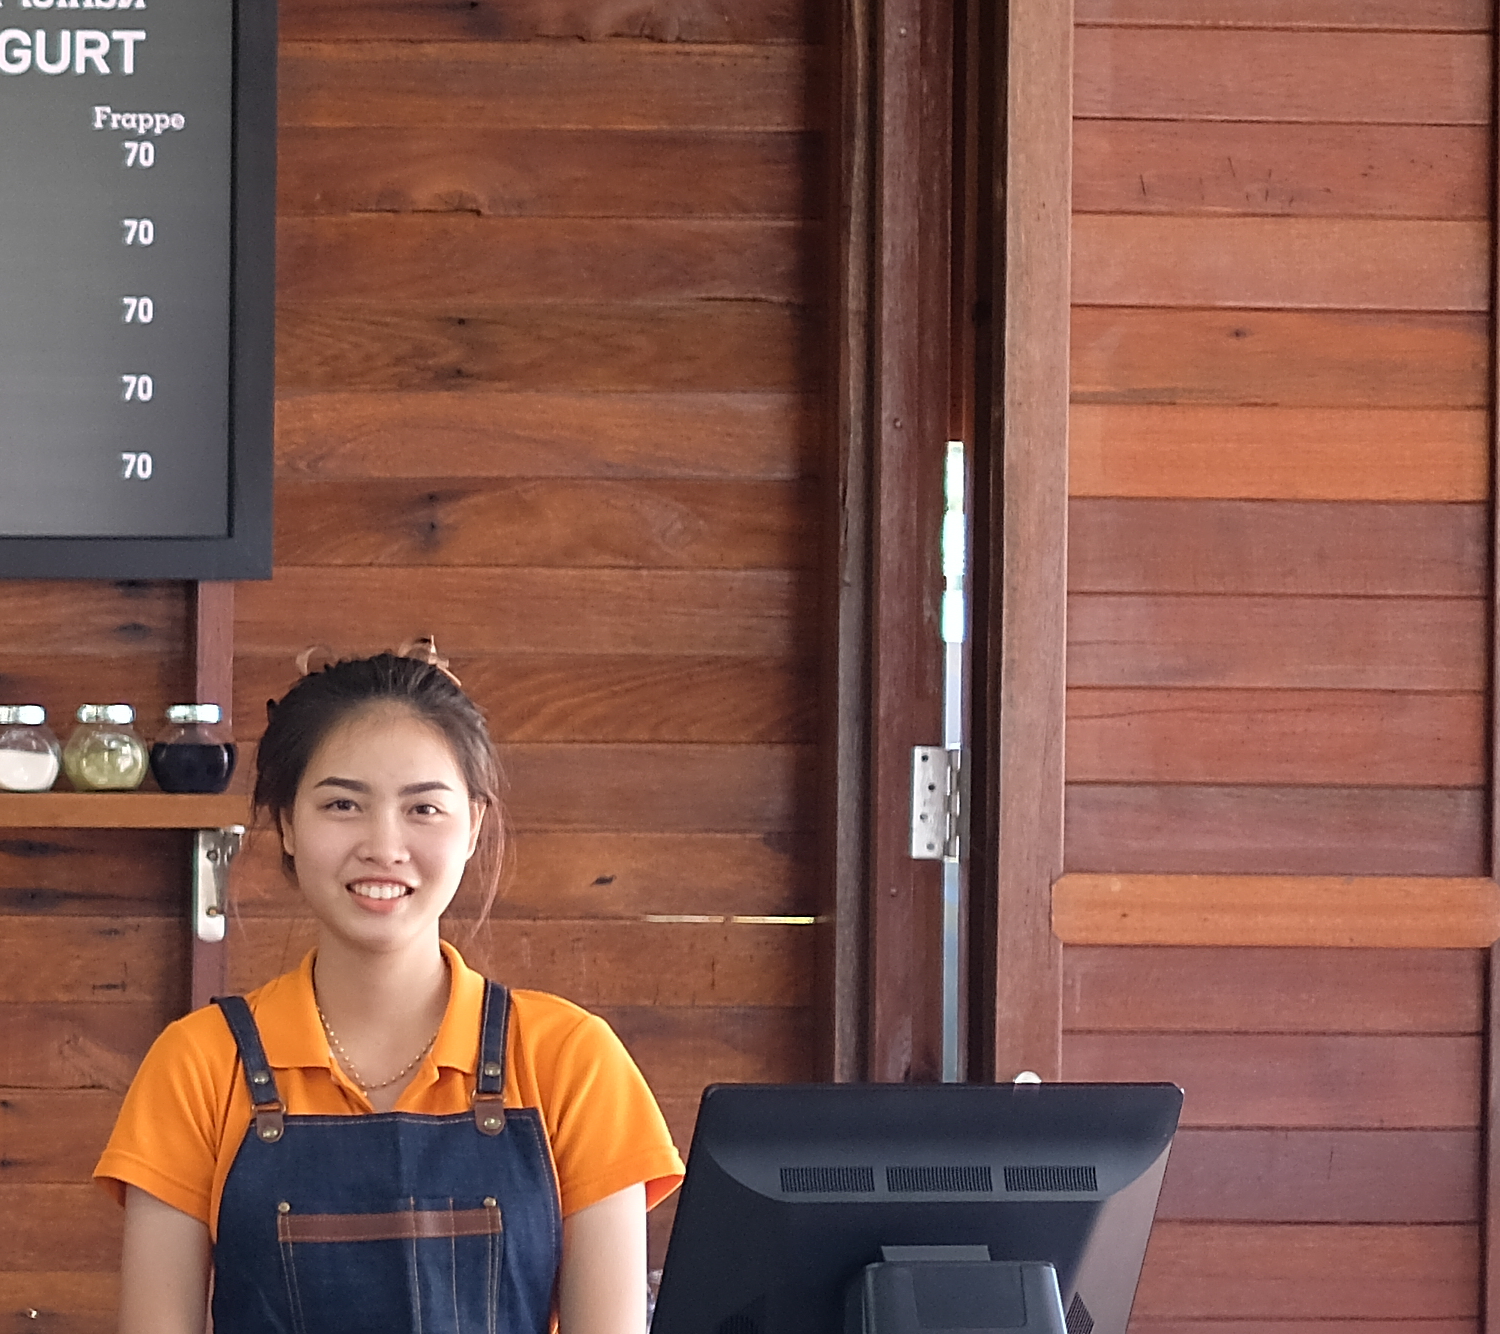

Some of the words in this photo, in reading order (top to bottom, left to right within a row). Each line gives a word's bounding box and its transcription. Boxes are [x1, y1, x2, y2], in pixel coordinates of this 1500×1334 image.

[93, 106, 186, 135] Frappe
[124, 141, 155, 167] 70
[123, 219, 154, 245] 70
[122, 296, 154, 323] 70
[121, 374, 153, 401] 70
[121, 452, 153, 479] 70
